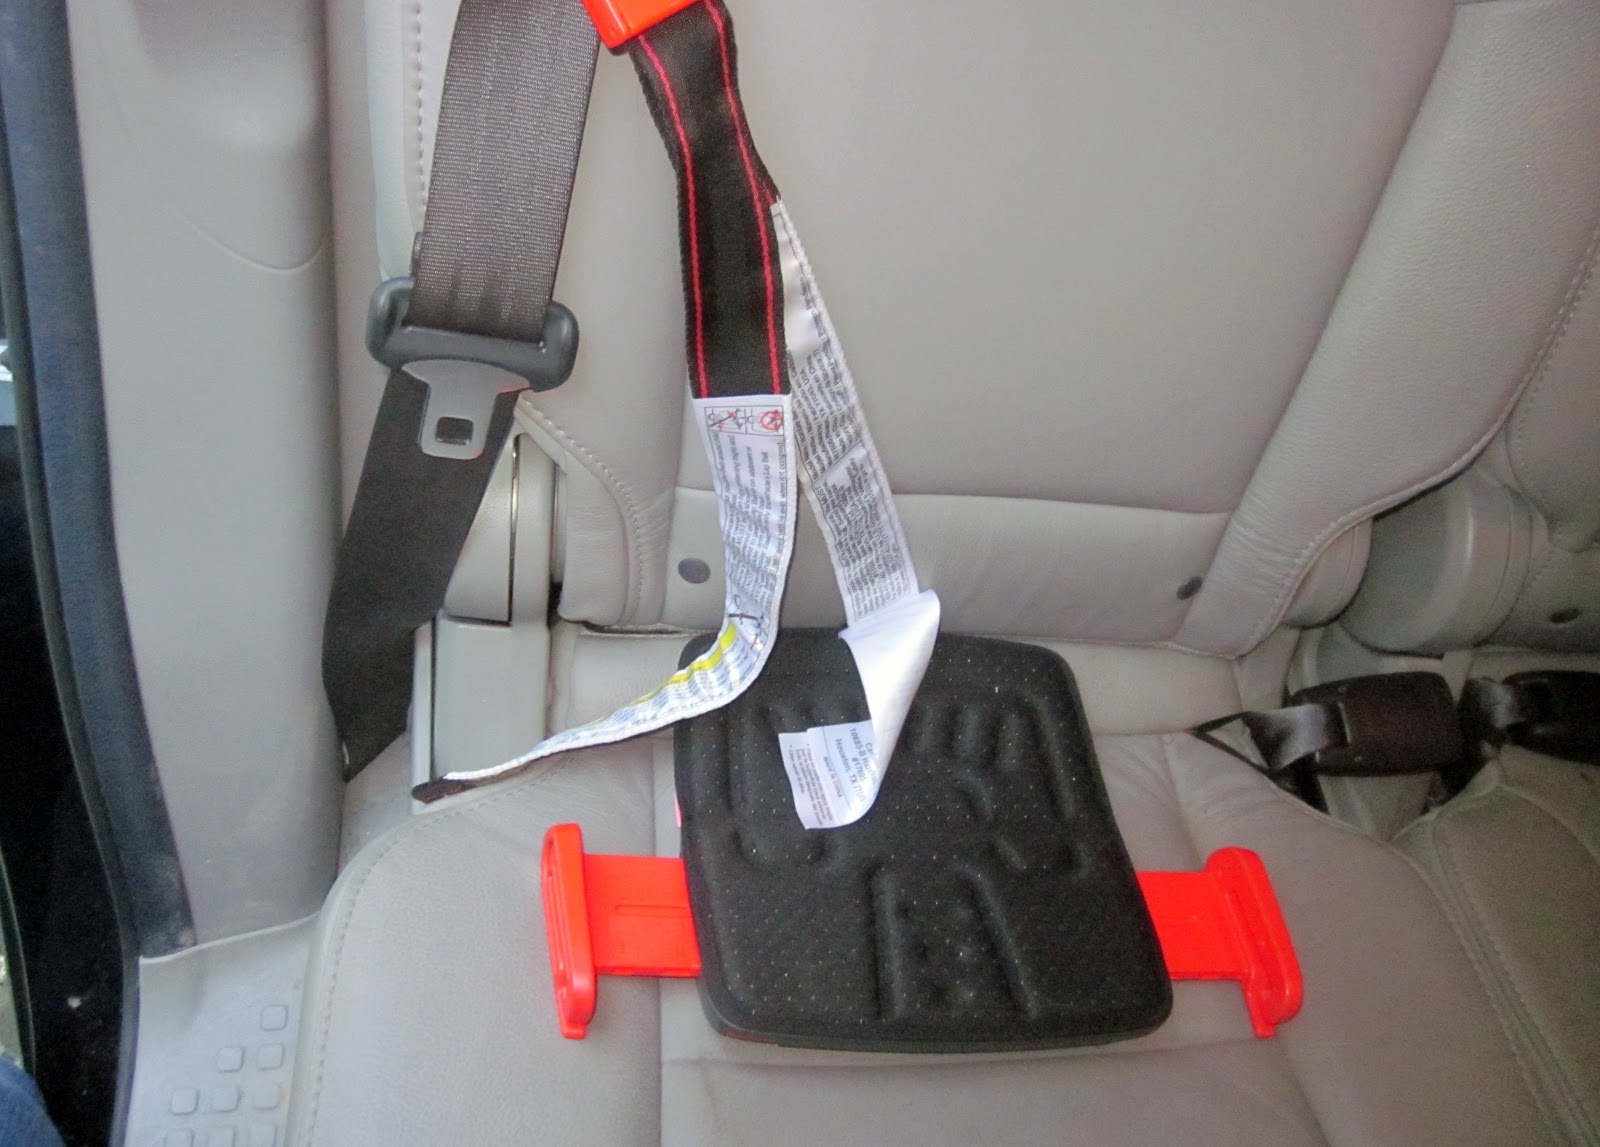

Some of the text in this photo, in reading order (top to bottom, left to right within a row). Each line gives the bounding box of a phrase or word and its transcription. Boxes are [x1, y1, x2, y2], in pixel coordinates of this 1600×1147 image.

[798, 367, 811, 385] USA
[833, 737, 851, 773] Houston,
[848, 773, 857, 785] TX
